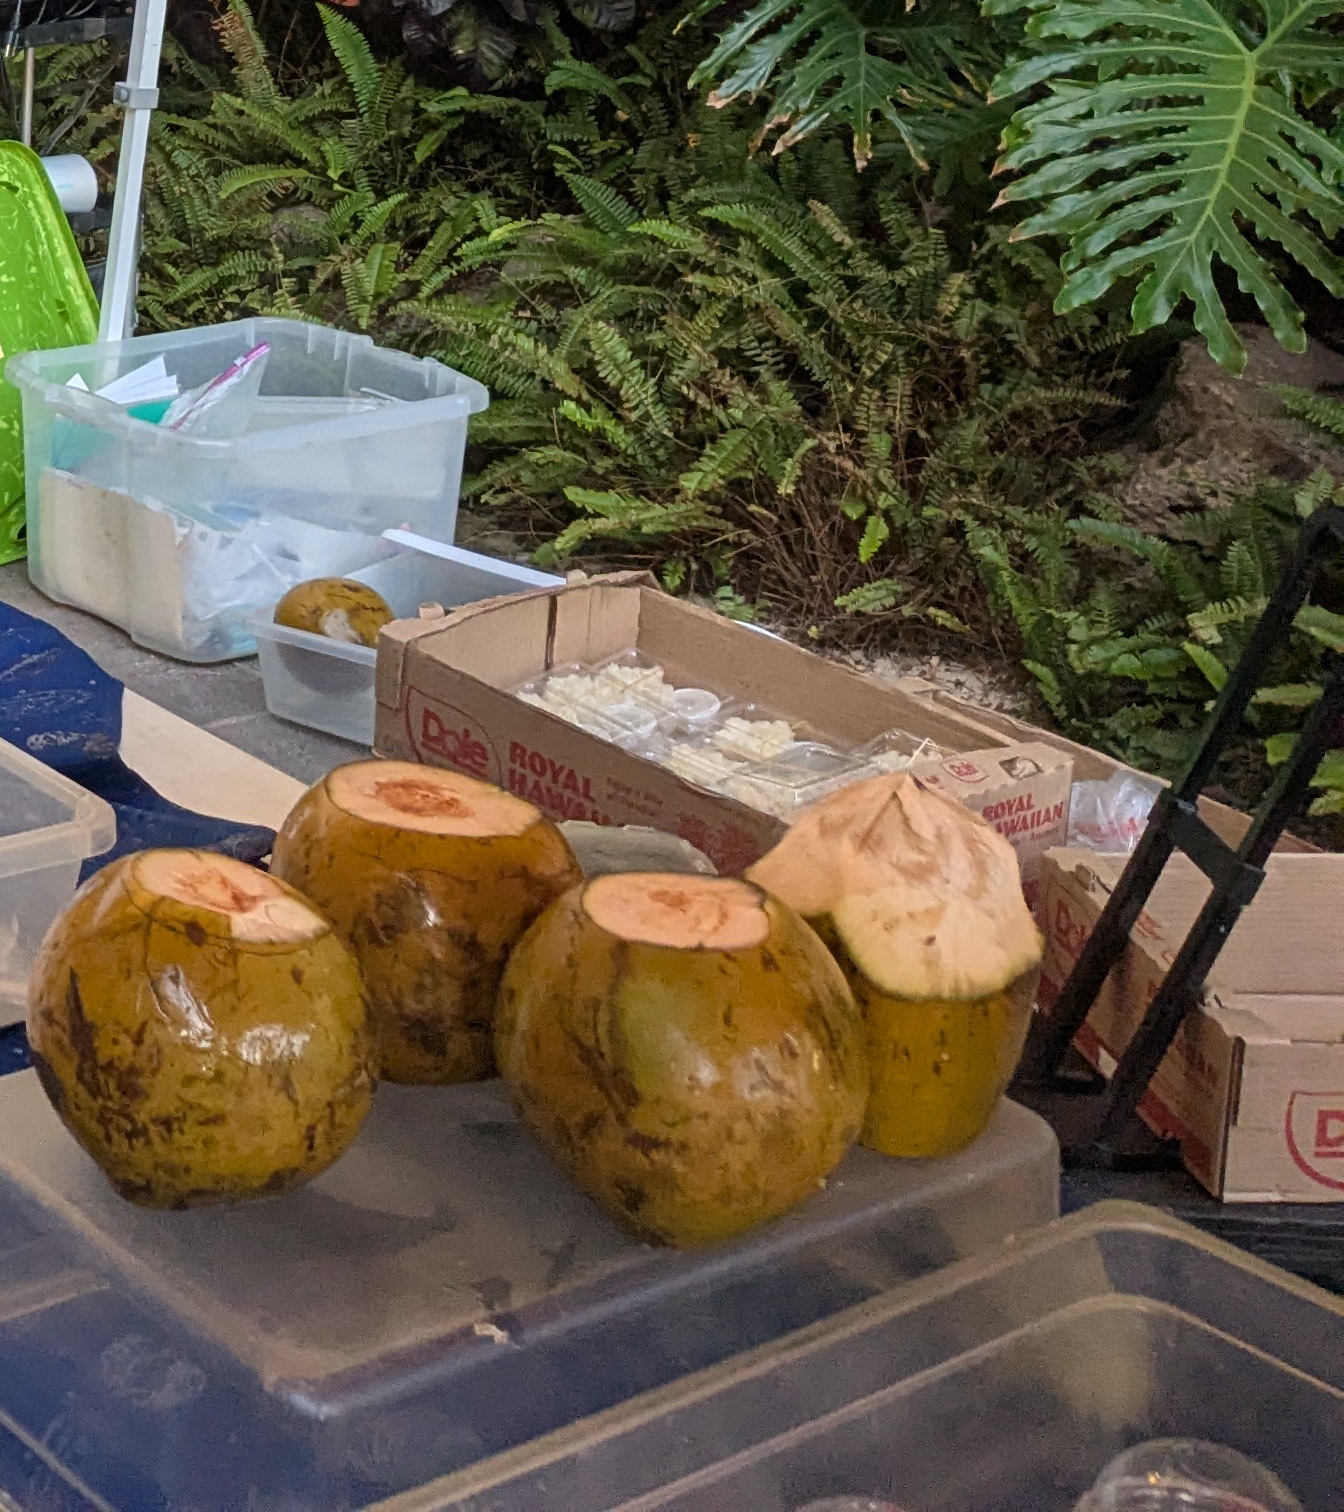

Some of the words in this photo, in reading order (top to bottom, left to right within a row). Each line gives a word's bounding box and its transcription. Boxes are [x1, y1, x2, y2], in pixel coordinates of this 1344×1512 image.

[422, 706, 490, 770] Dole
[509, 739, 597, 803] ROYAL
[982, 793, 1035, 822] ROYAL
